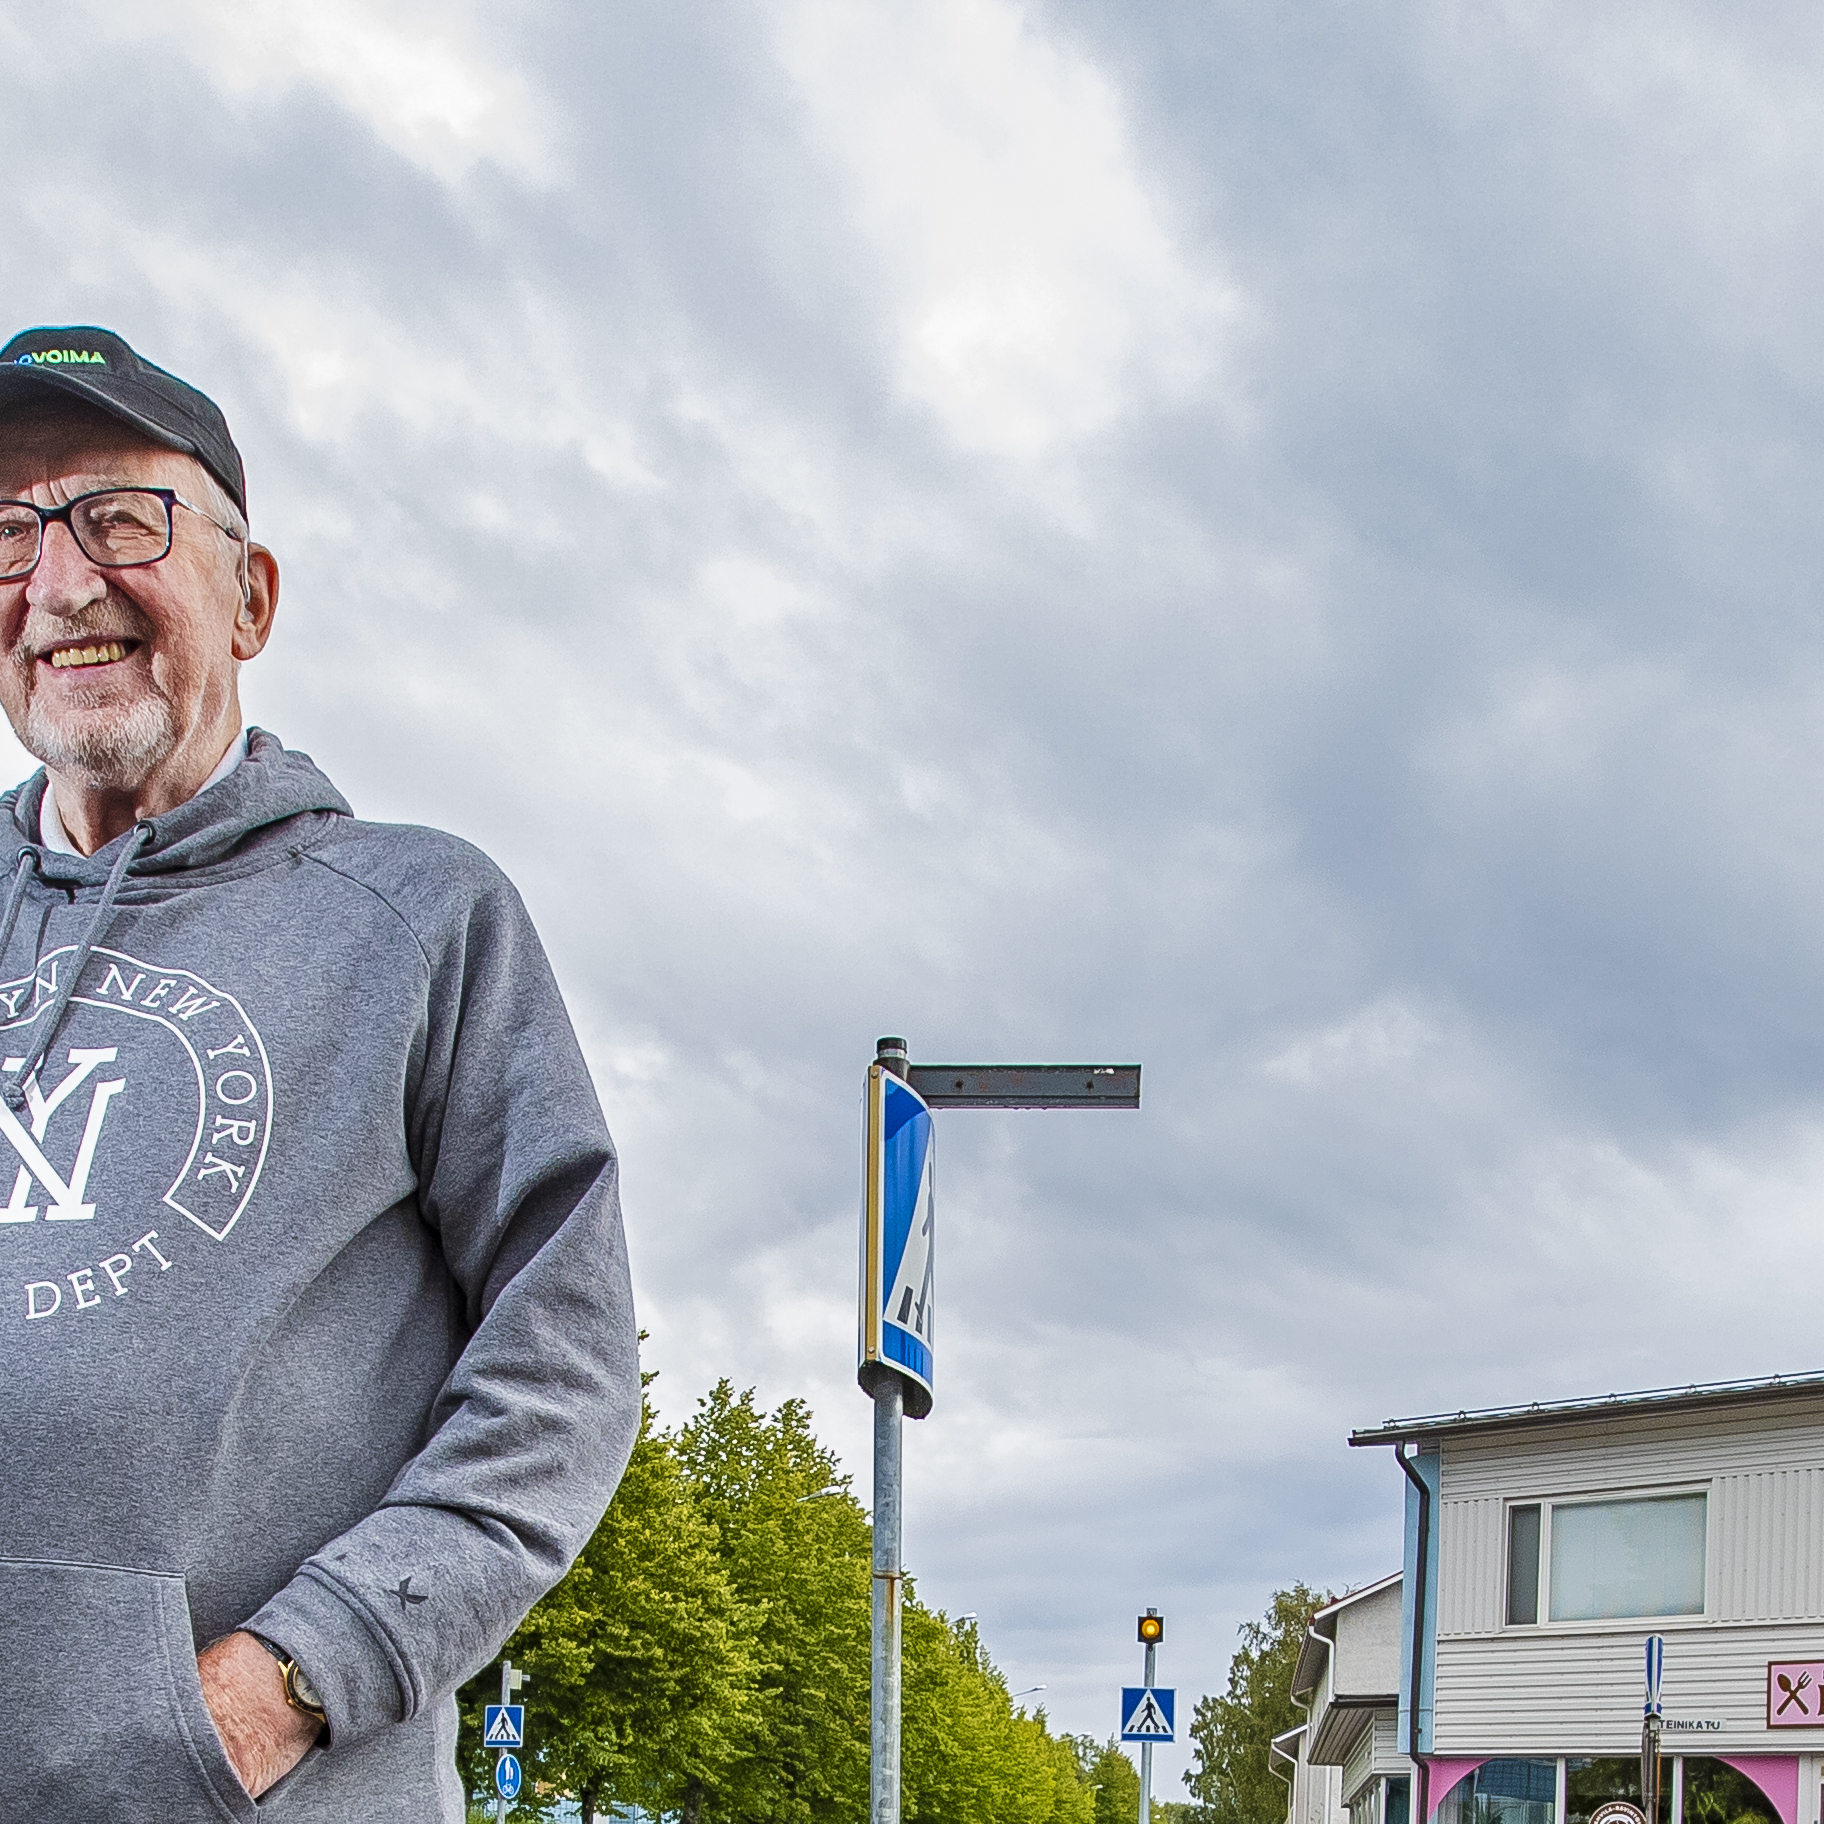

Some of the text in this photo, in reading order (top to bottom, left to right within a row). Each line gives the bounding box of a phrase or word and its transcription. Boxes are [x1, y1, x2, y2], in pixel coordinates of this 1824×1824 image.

[96, 963, 220, 1021] NEW
[197, 1033, 258, 1194] YORK
[24, 1229, 174, 1321] DEPT
